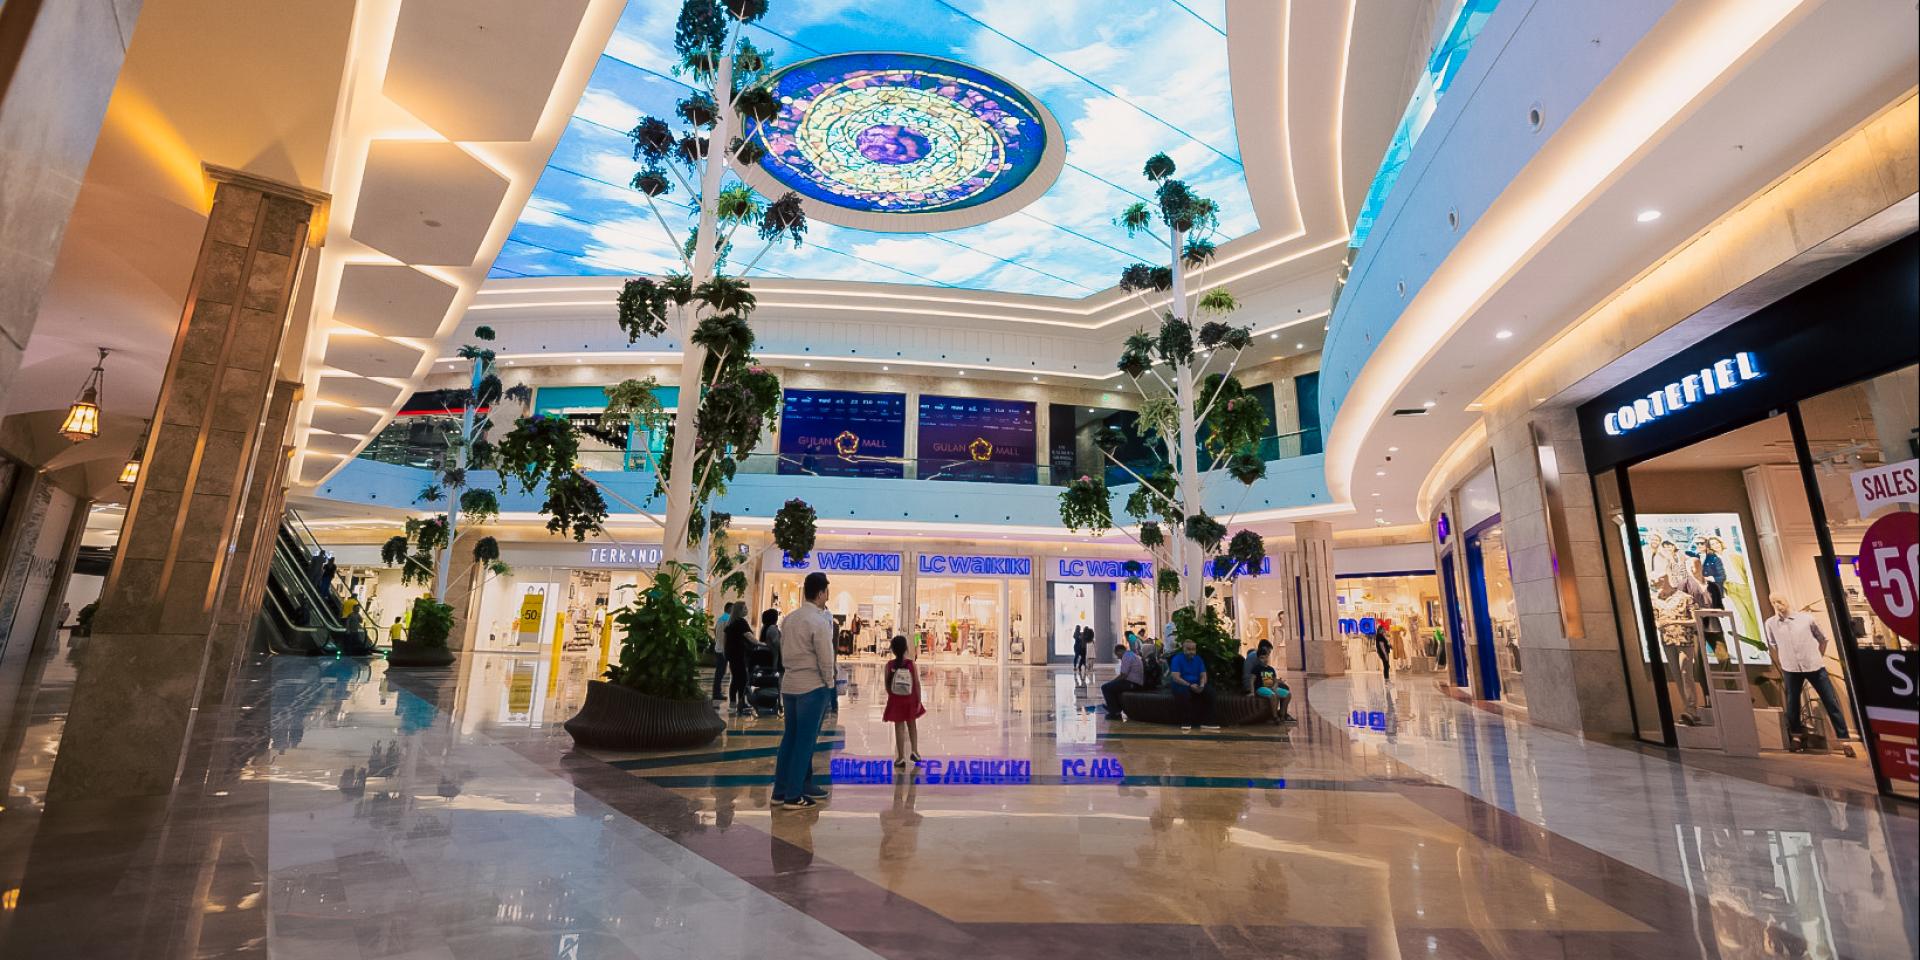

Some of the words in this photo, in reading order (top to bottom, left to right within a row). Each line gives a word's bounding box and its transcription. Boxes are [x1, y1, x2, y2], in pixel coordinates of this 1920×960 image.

[1604, 352, 1762, 435] CORTEFIEL
[798, 435, 832, 447] GULAN
[862, 439, 887, 448] MALL
[933, 443, 966, 453] GULAN
[995, 447, 1020, 456] MALL
[1862, 468, 1918, 501] SALES
[591, 548, 663, 563] TERRANO
[919, 555, 946, 573] LC
[1059, 559, 1084, 577] LC
